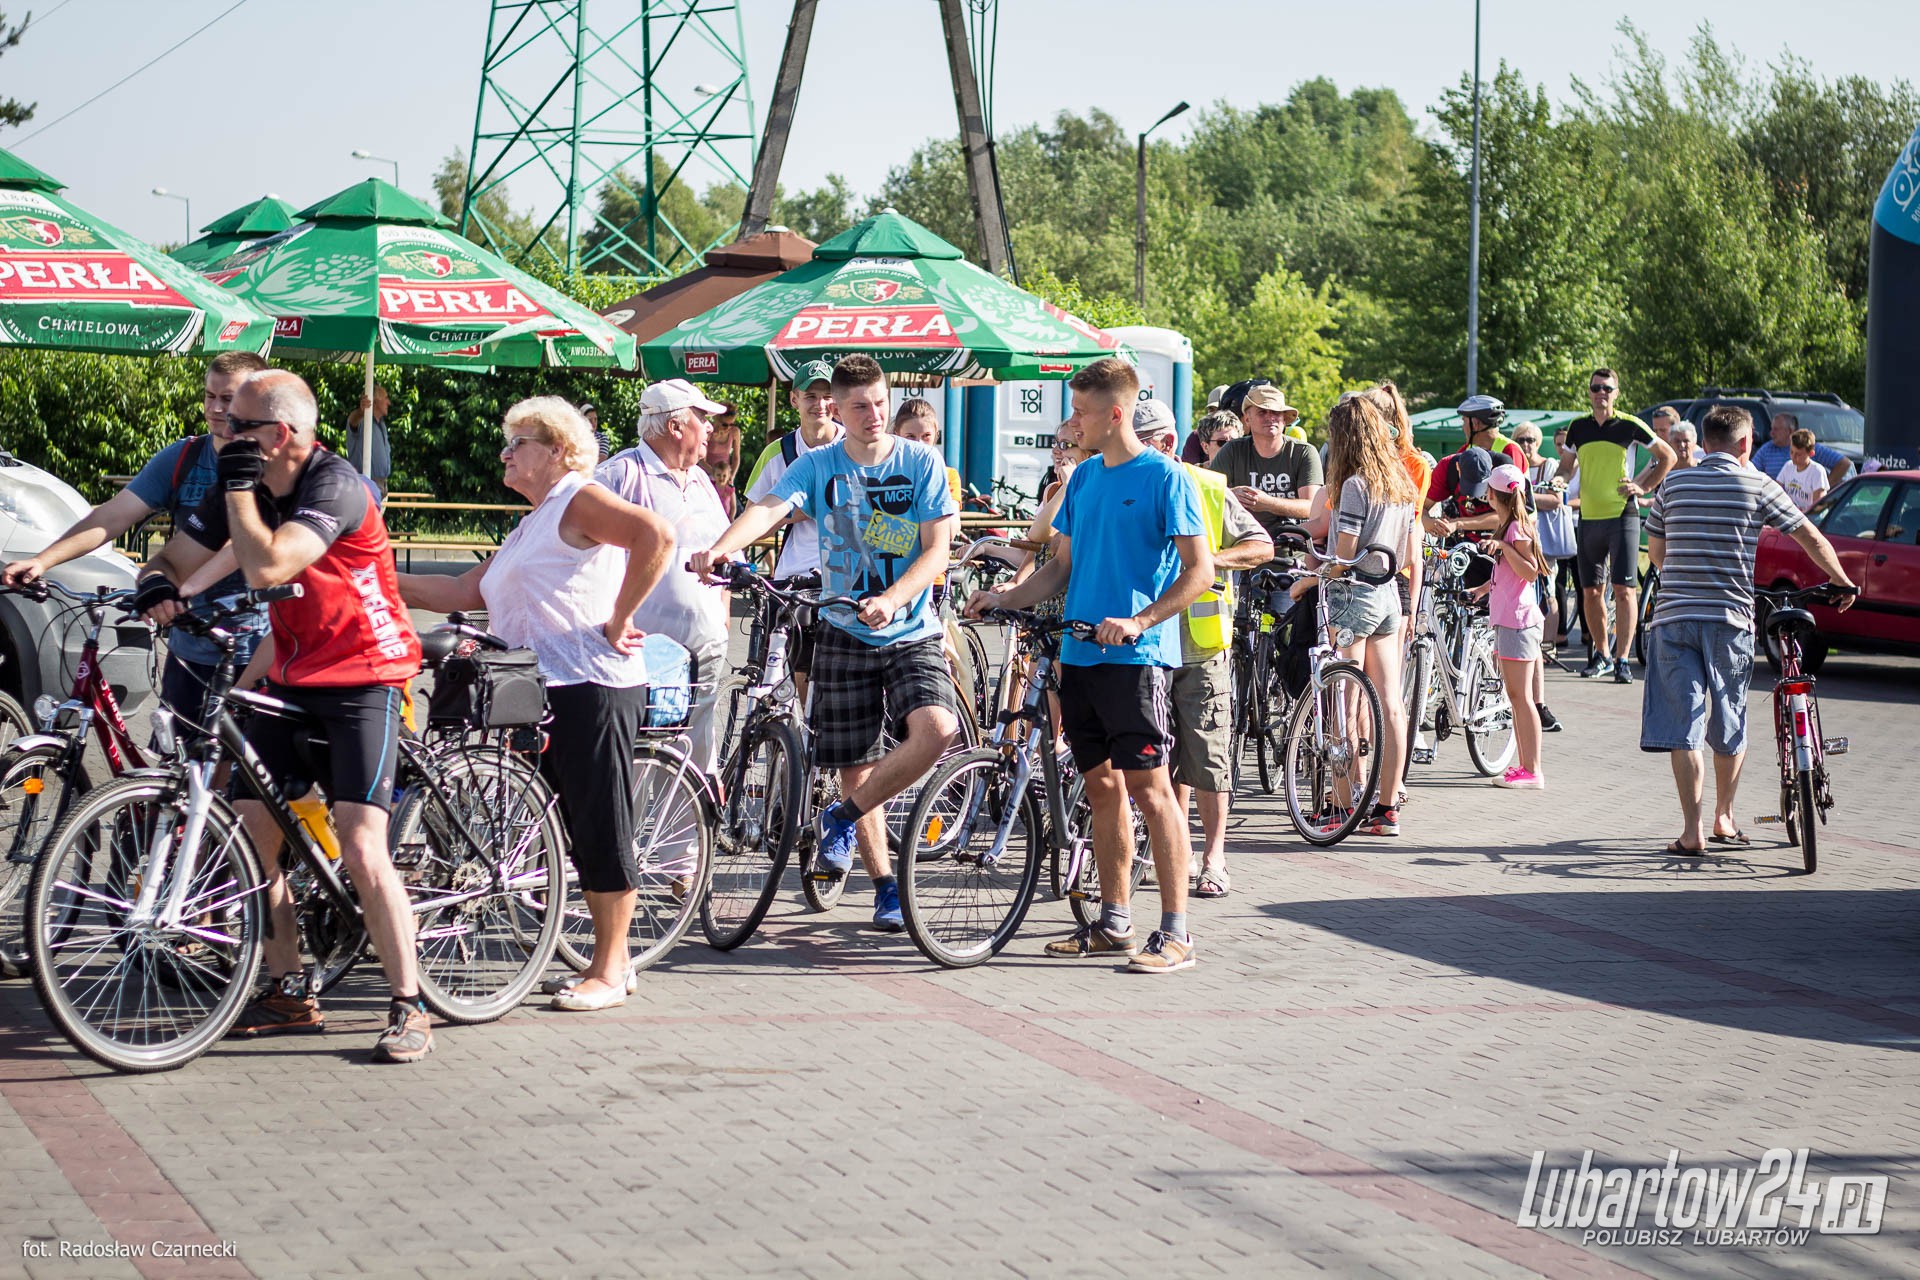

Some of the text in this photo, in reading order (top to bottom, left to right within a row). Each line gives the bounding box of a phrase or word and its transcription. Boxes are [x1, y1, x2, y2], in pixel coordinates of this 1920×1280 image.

[379, 287, 539, 314] PERŁA
[38, 315, 141, 337] CHMIELOWA
[784, 314, 953, 339] PERŁA
[688, 356, 716, 369] PERŁA
[1020, 386, 1042, 401] TOI
[1020, 401, 1042, 414] TOI
[1249, 471, 1291, 491] Lee
[884, 489, 913, 503] MCR
